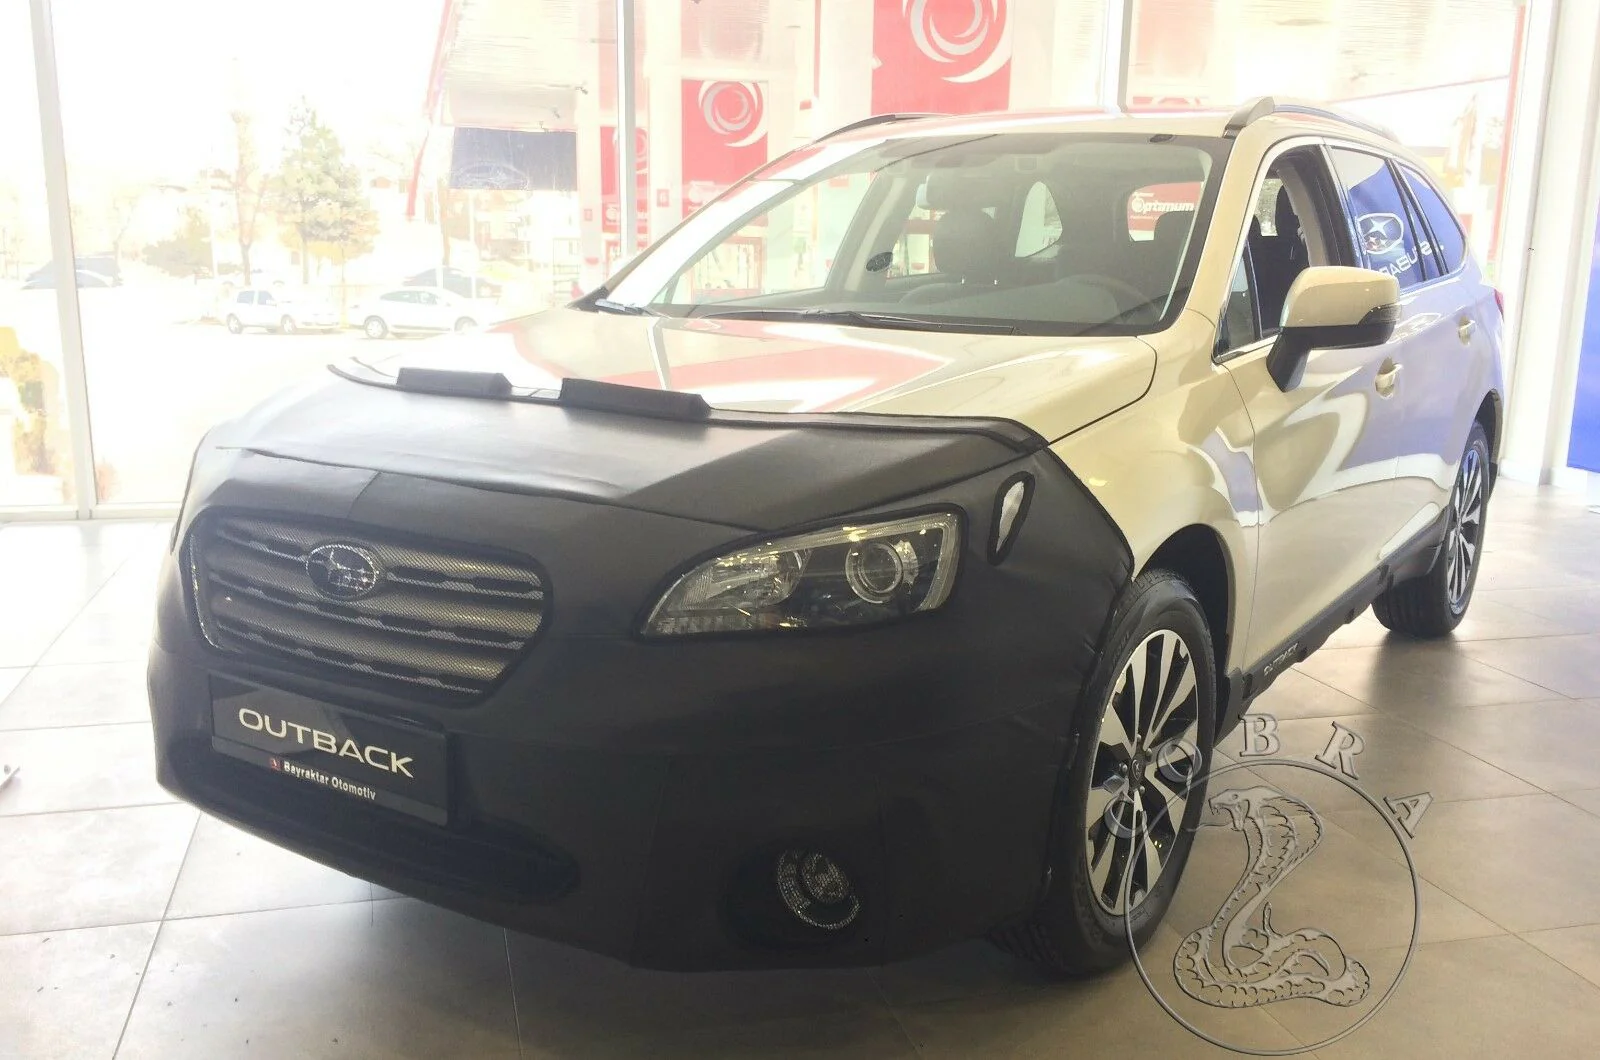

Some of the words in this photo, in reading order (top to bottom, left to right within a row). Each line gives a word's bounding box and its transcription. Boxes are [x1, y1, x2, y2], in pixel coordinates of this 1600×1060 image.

[238, 707, 415, 779] OUTBACK
[283, 761, 330, 785] Bayraktar
[331, 776, 376, 801] Otomotiv
